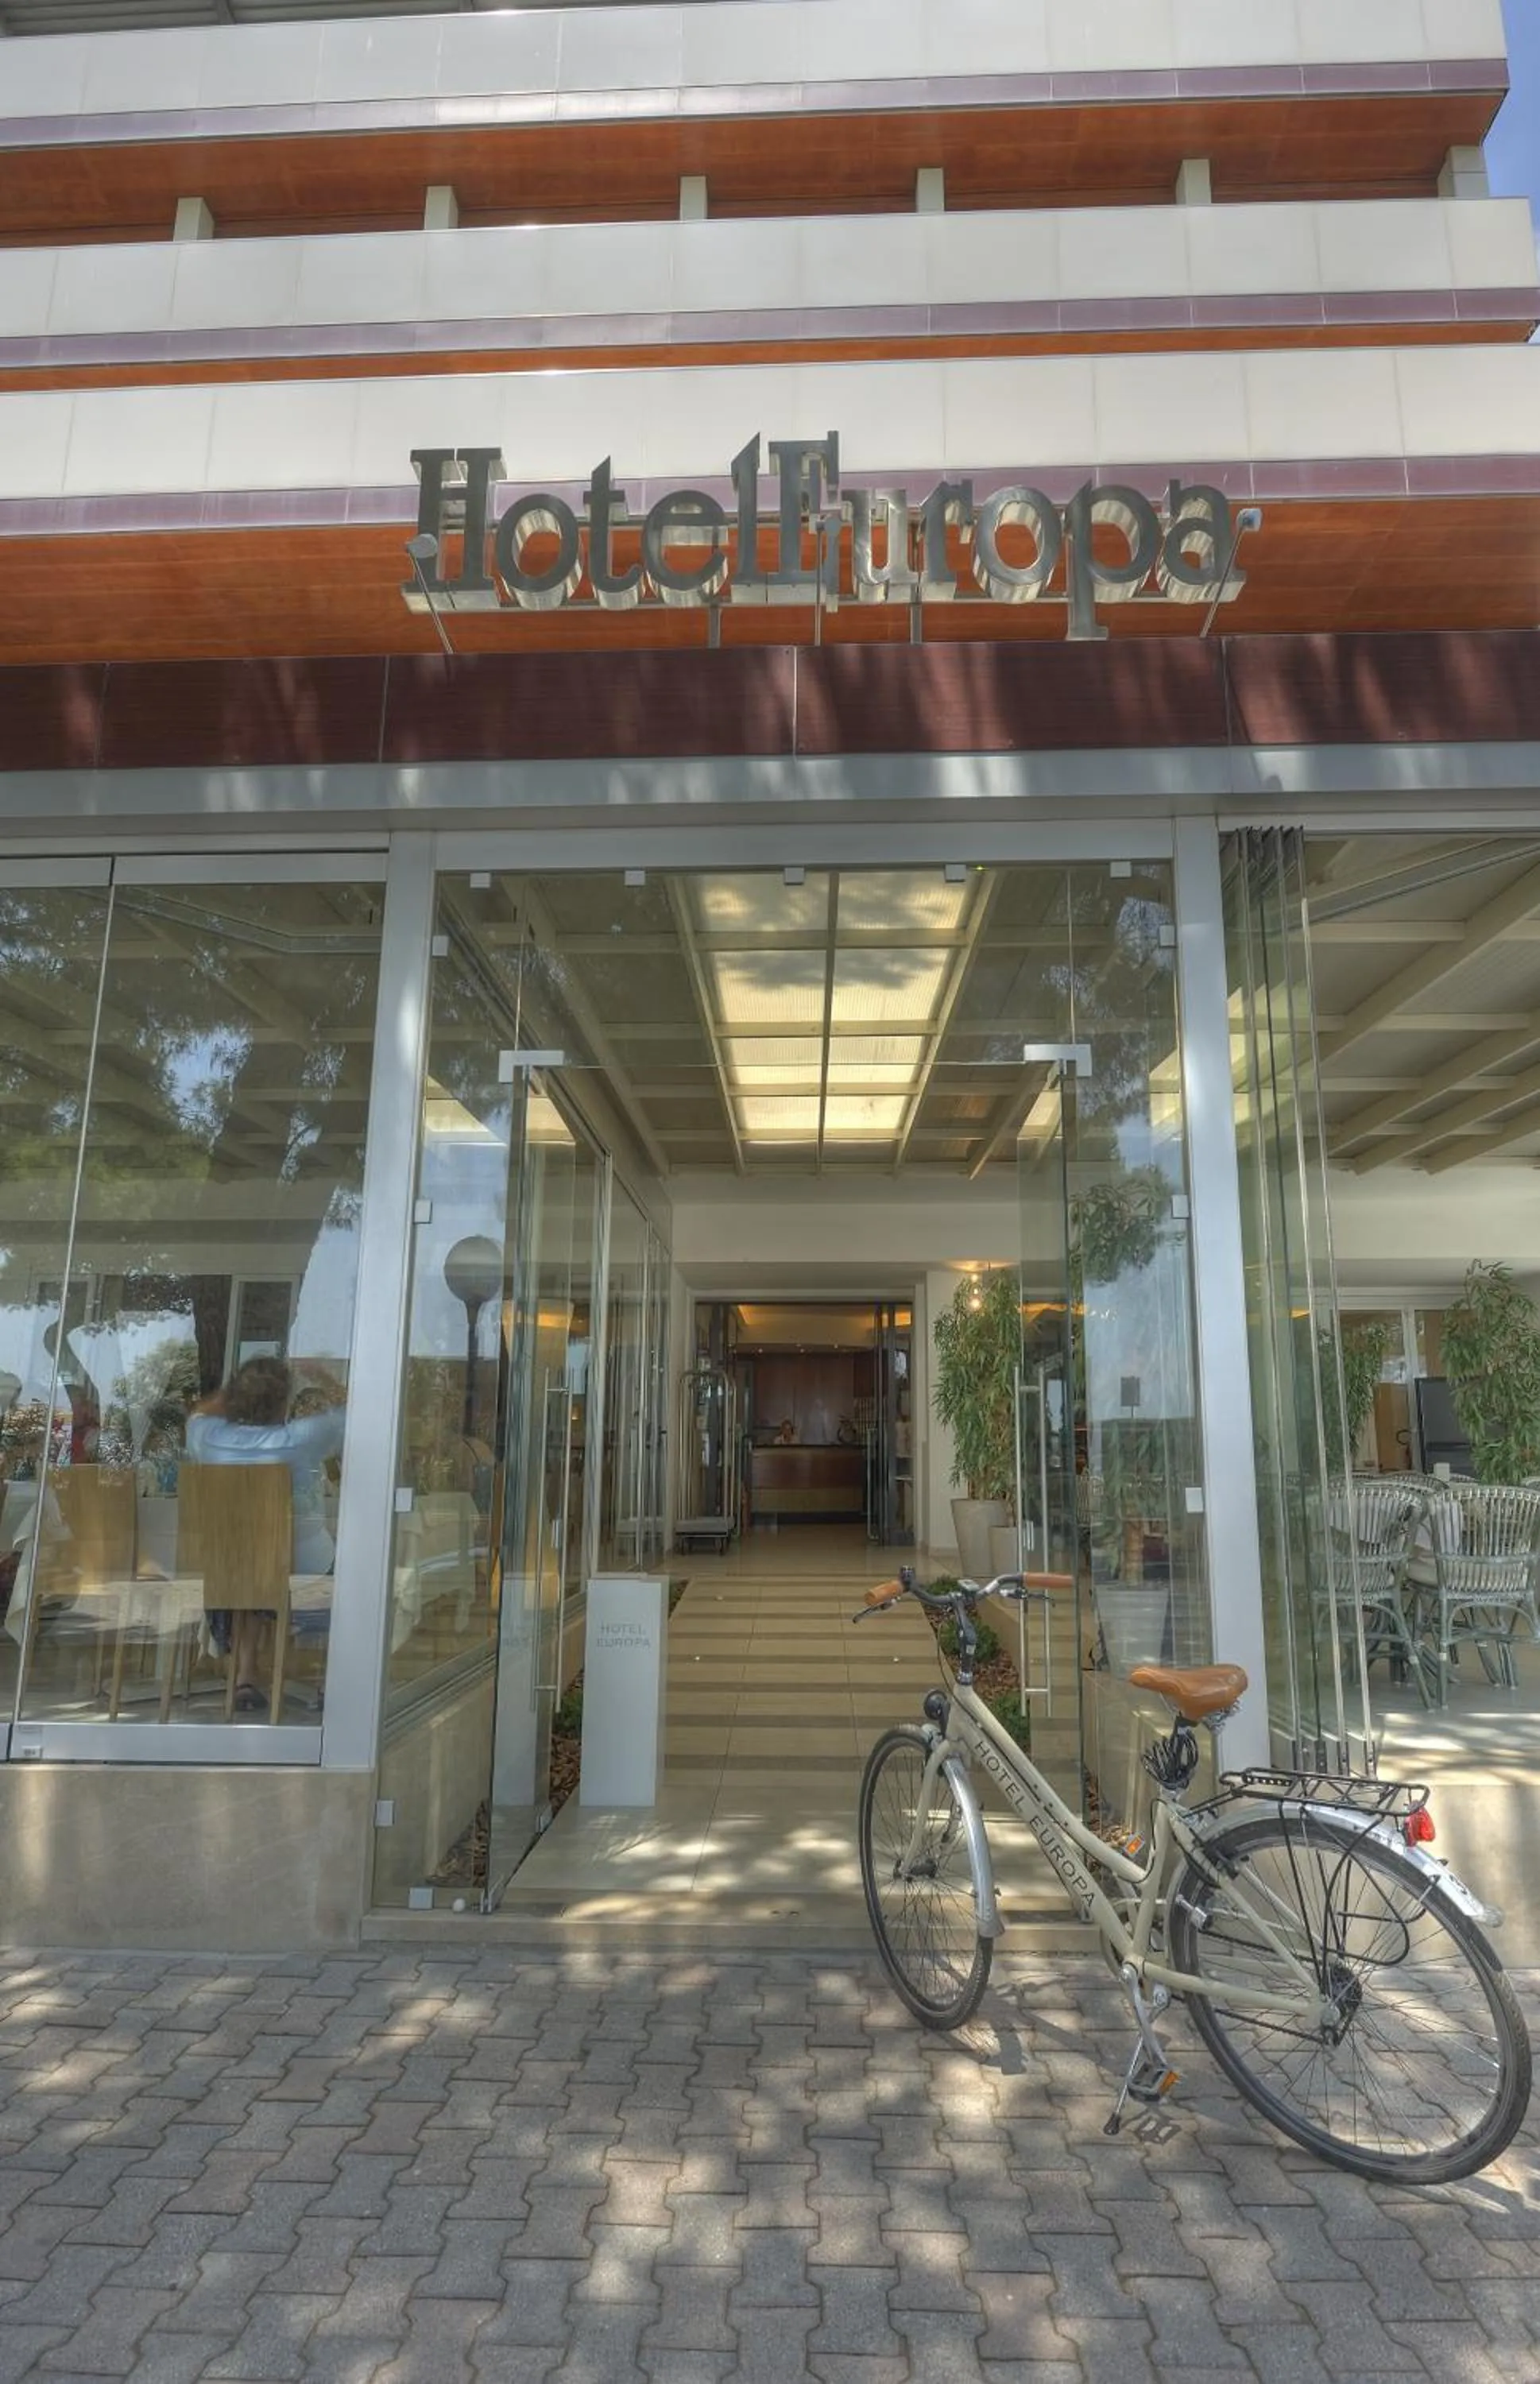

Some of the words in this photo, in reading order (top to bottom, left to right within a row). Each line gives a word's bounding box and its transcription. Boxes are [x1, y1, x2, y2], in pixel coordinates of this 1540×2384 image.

[600, 1624, 645, 1635] HOTEL
[975, 1740, 1026, 1813] HOTEL
[1029, 1815, 1096, 1908] EUROPA
